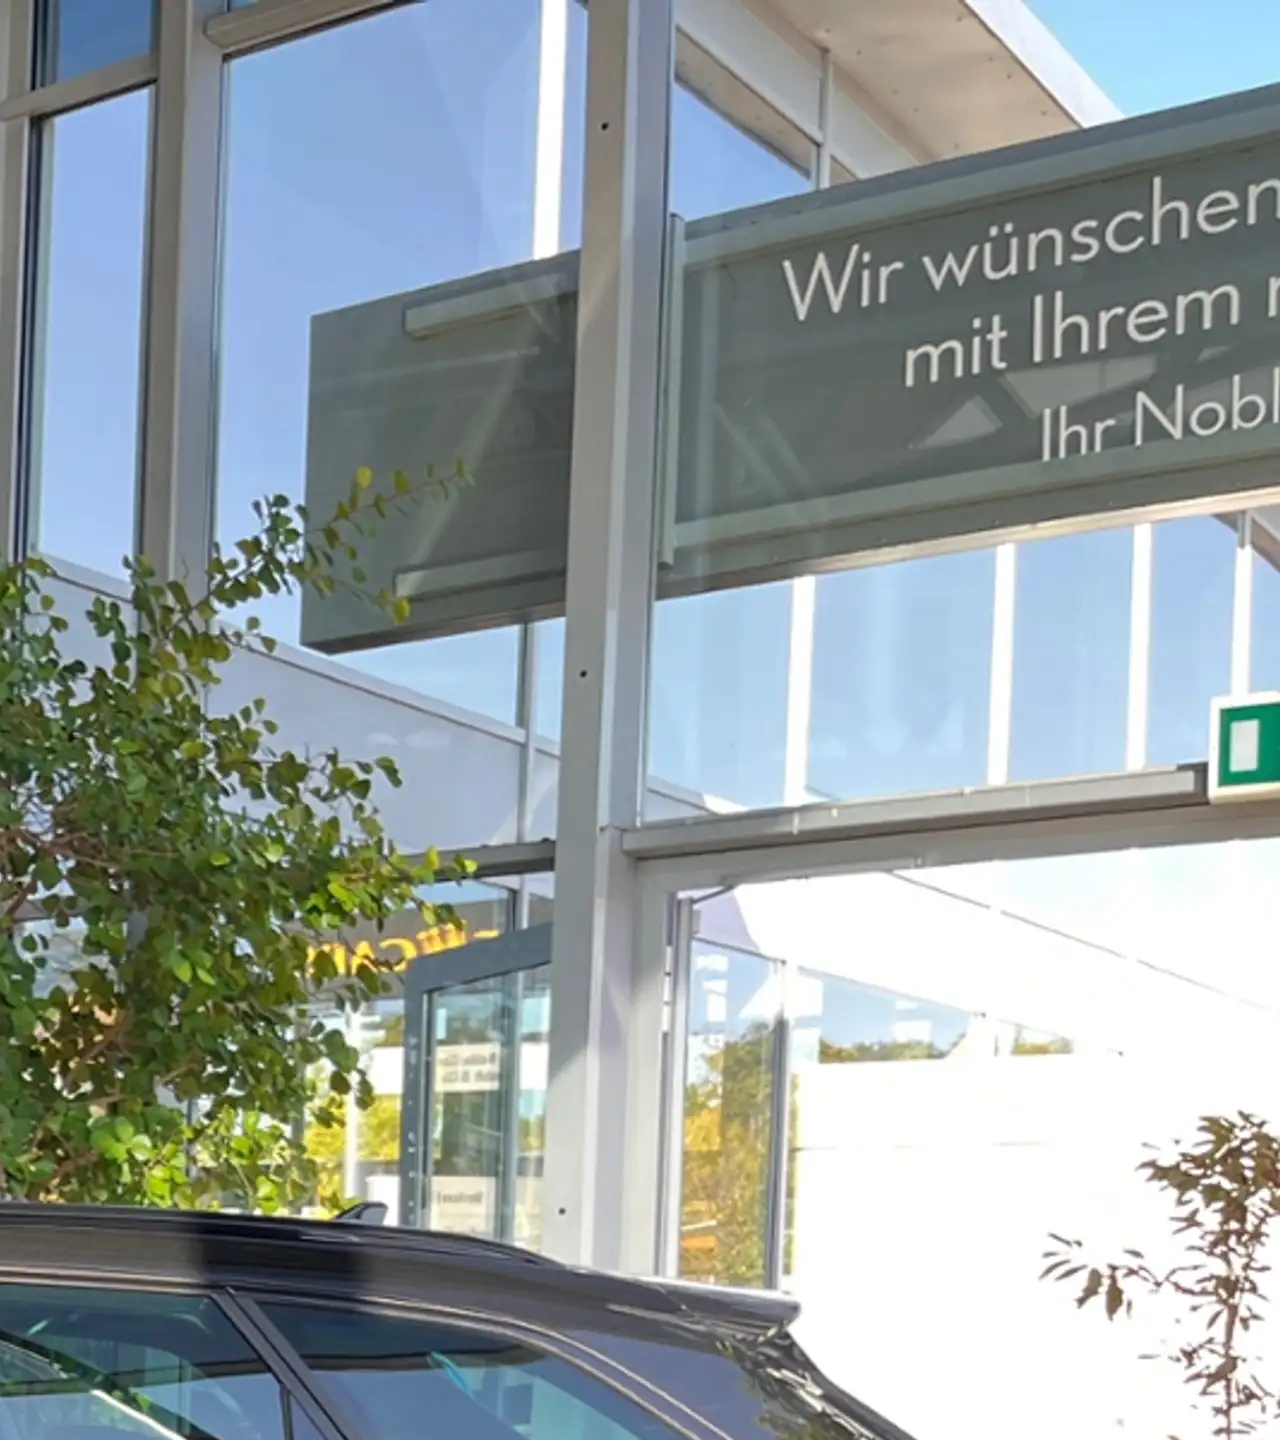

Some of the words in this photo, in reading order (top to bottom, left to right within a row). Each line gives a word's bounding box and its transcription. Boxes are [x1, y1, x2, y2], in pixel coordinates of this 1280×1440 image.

[782, 243, 904, 322] Wir
[922, 175, 1280, 292] wünschen
[905, 314, 1008, 388] mit
[1032, 290, 1240, 363] Ihrem
[1042, 405, 1116, 462] Ihr
